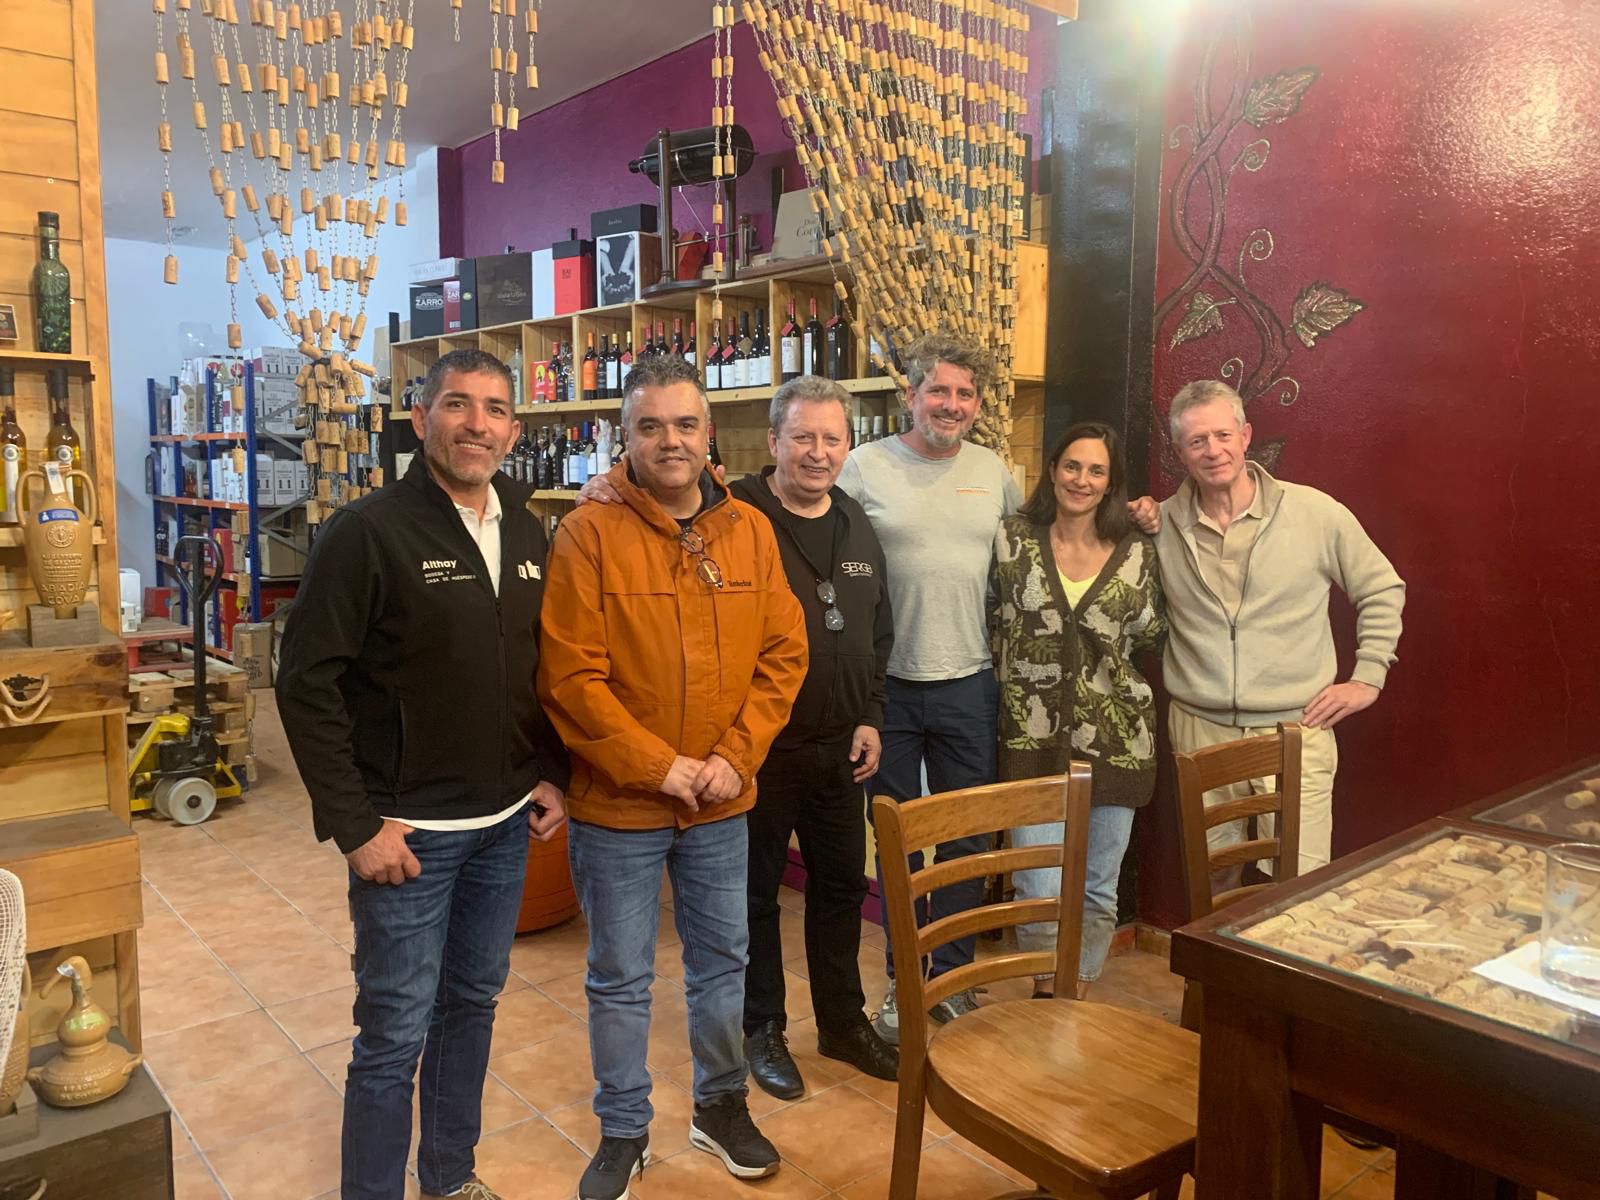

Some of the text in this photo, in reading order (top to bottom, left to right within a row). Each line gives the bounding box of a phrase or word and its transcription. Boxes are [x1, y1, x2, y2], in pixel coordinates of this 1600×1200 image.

[415, 298, 444, 306] ZARRO
[422, 560, 457, 570] Althay
[48, 595, 80, 605] COVA
